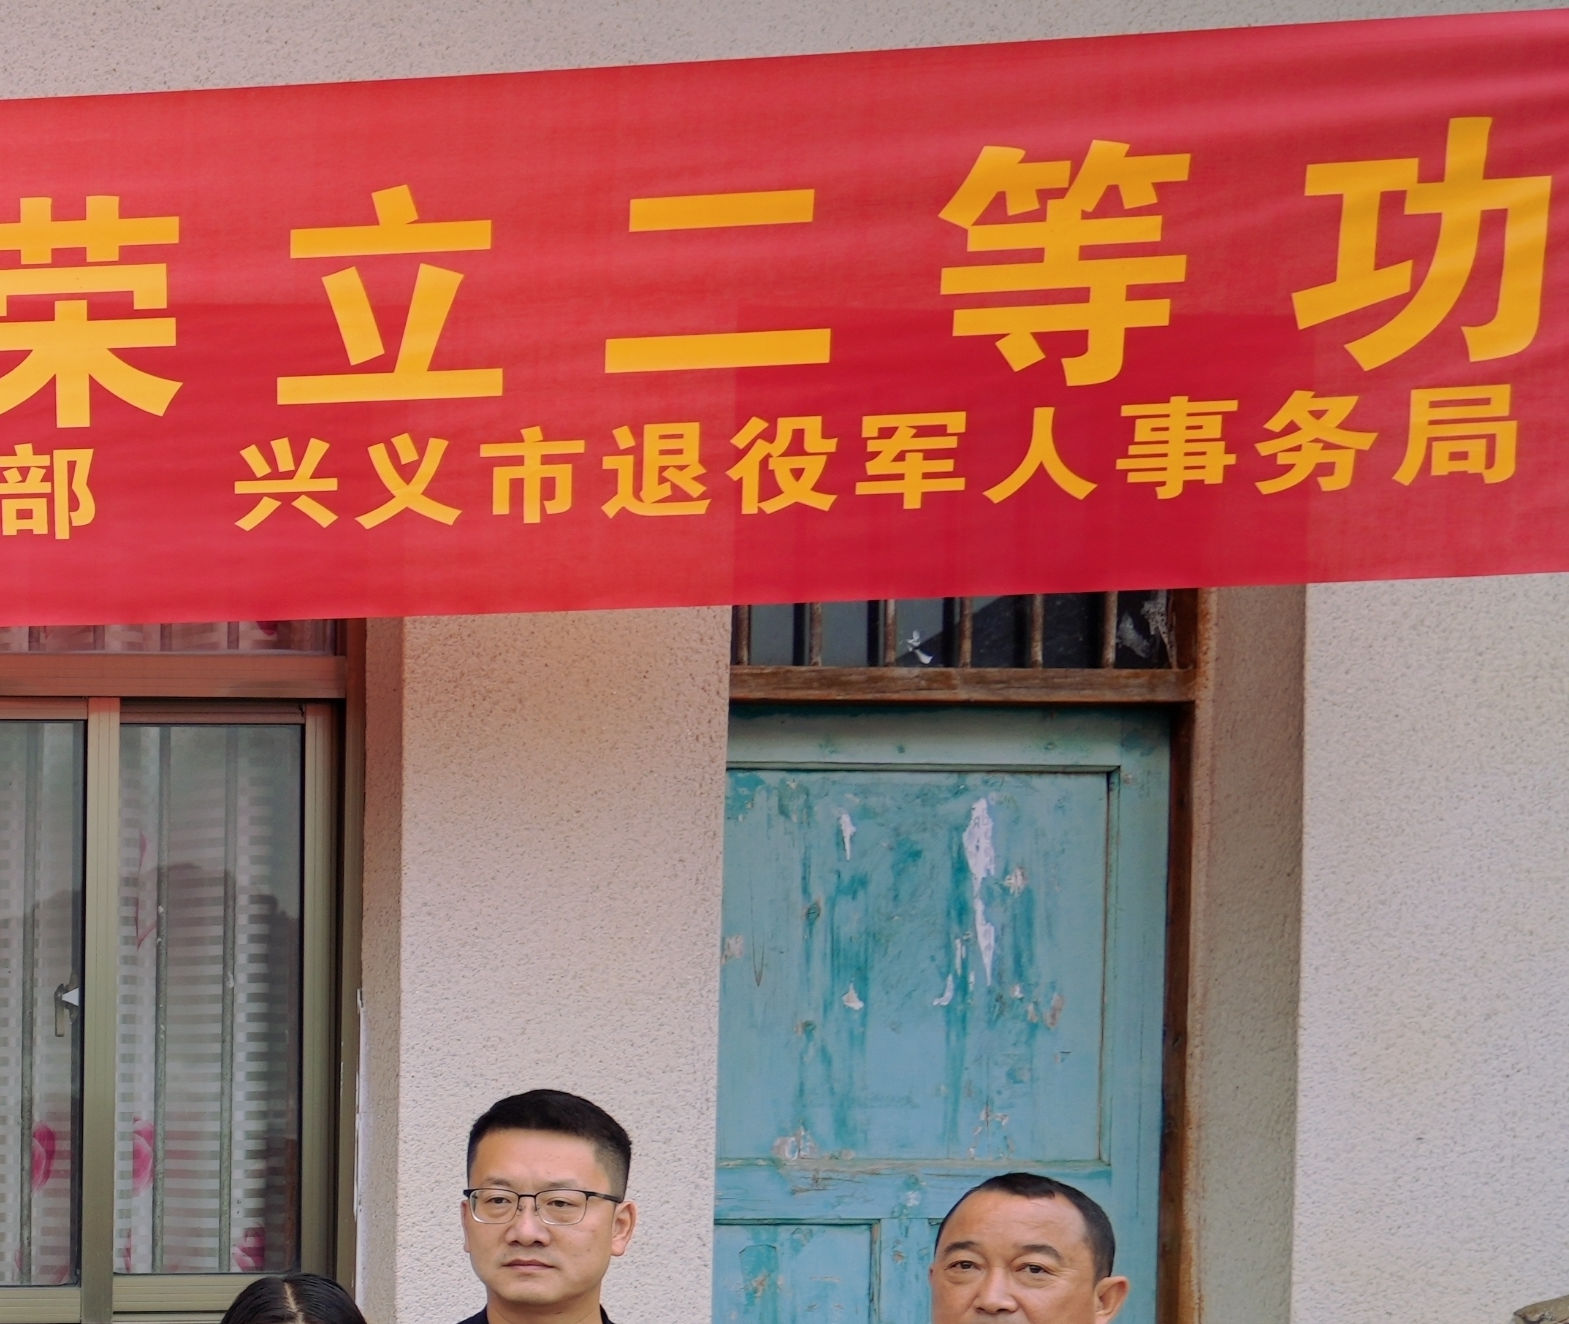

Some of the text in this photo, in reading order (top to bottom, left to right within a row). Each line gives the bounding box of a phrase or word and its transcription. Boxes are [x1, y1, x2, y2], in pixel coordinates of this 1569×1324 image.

[234, 383, 1519, 530] 兴义市退役军人事务局
